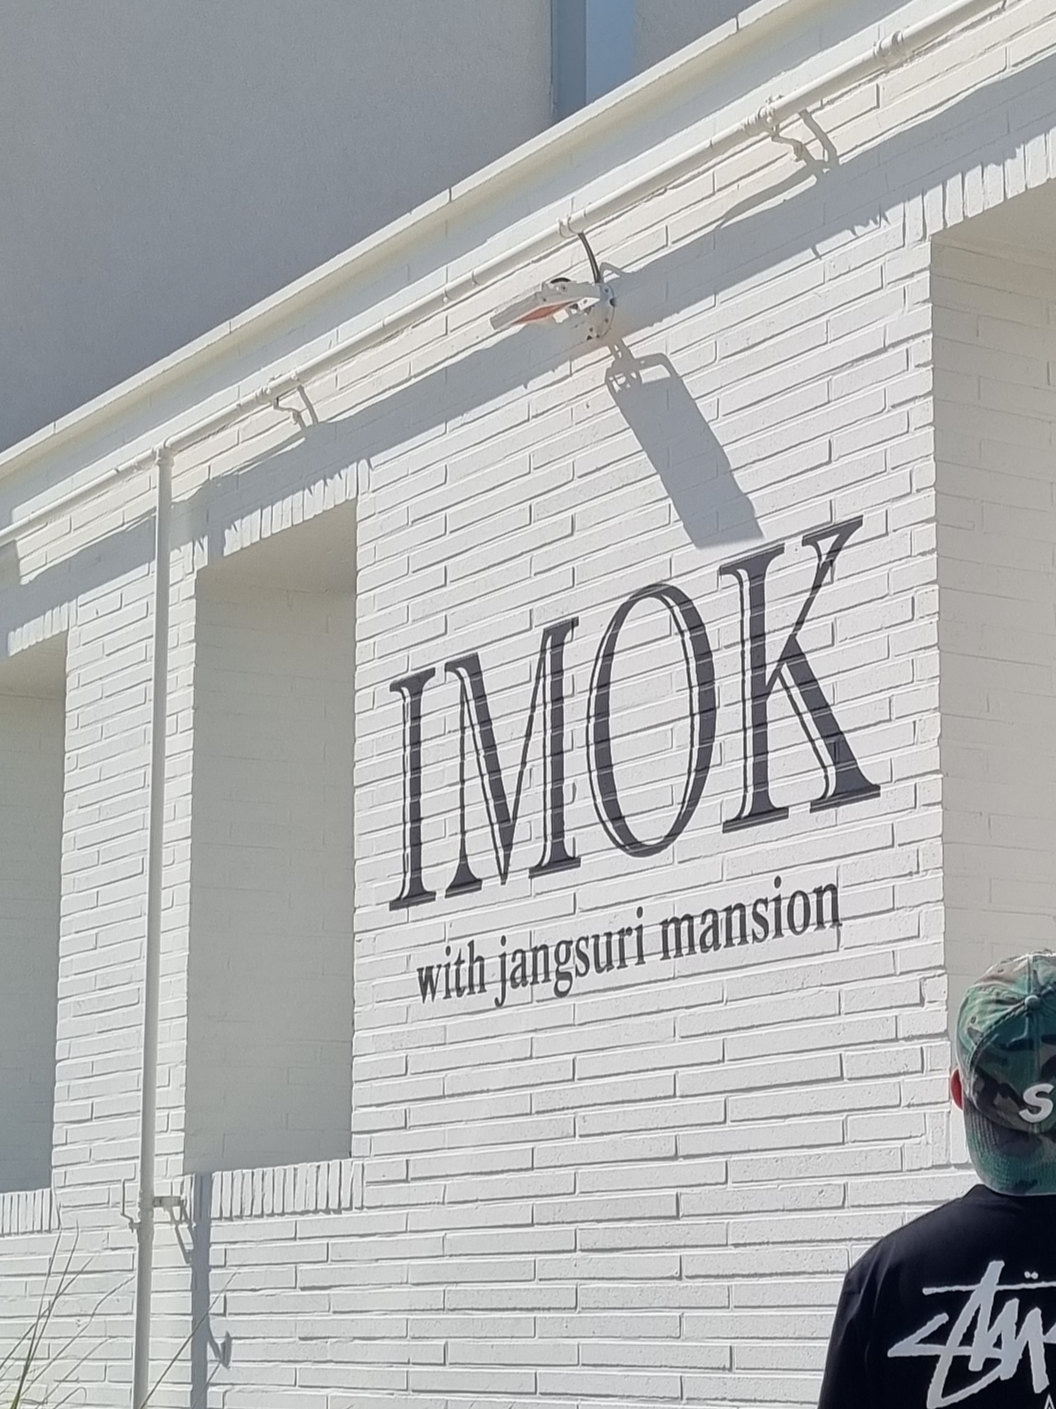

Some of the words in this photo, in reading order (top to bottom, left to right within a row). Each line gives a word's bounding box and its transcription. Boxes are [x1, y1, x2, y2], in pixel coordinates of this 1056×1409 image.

[389, 515, 881, 911] IMOK
[416, 940, 488, 1004] with
[494, 906, 646, 1008] jangsuri
[659, 875, 842, 962] mansion
[1018, 1083, 1055, 1123] S
